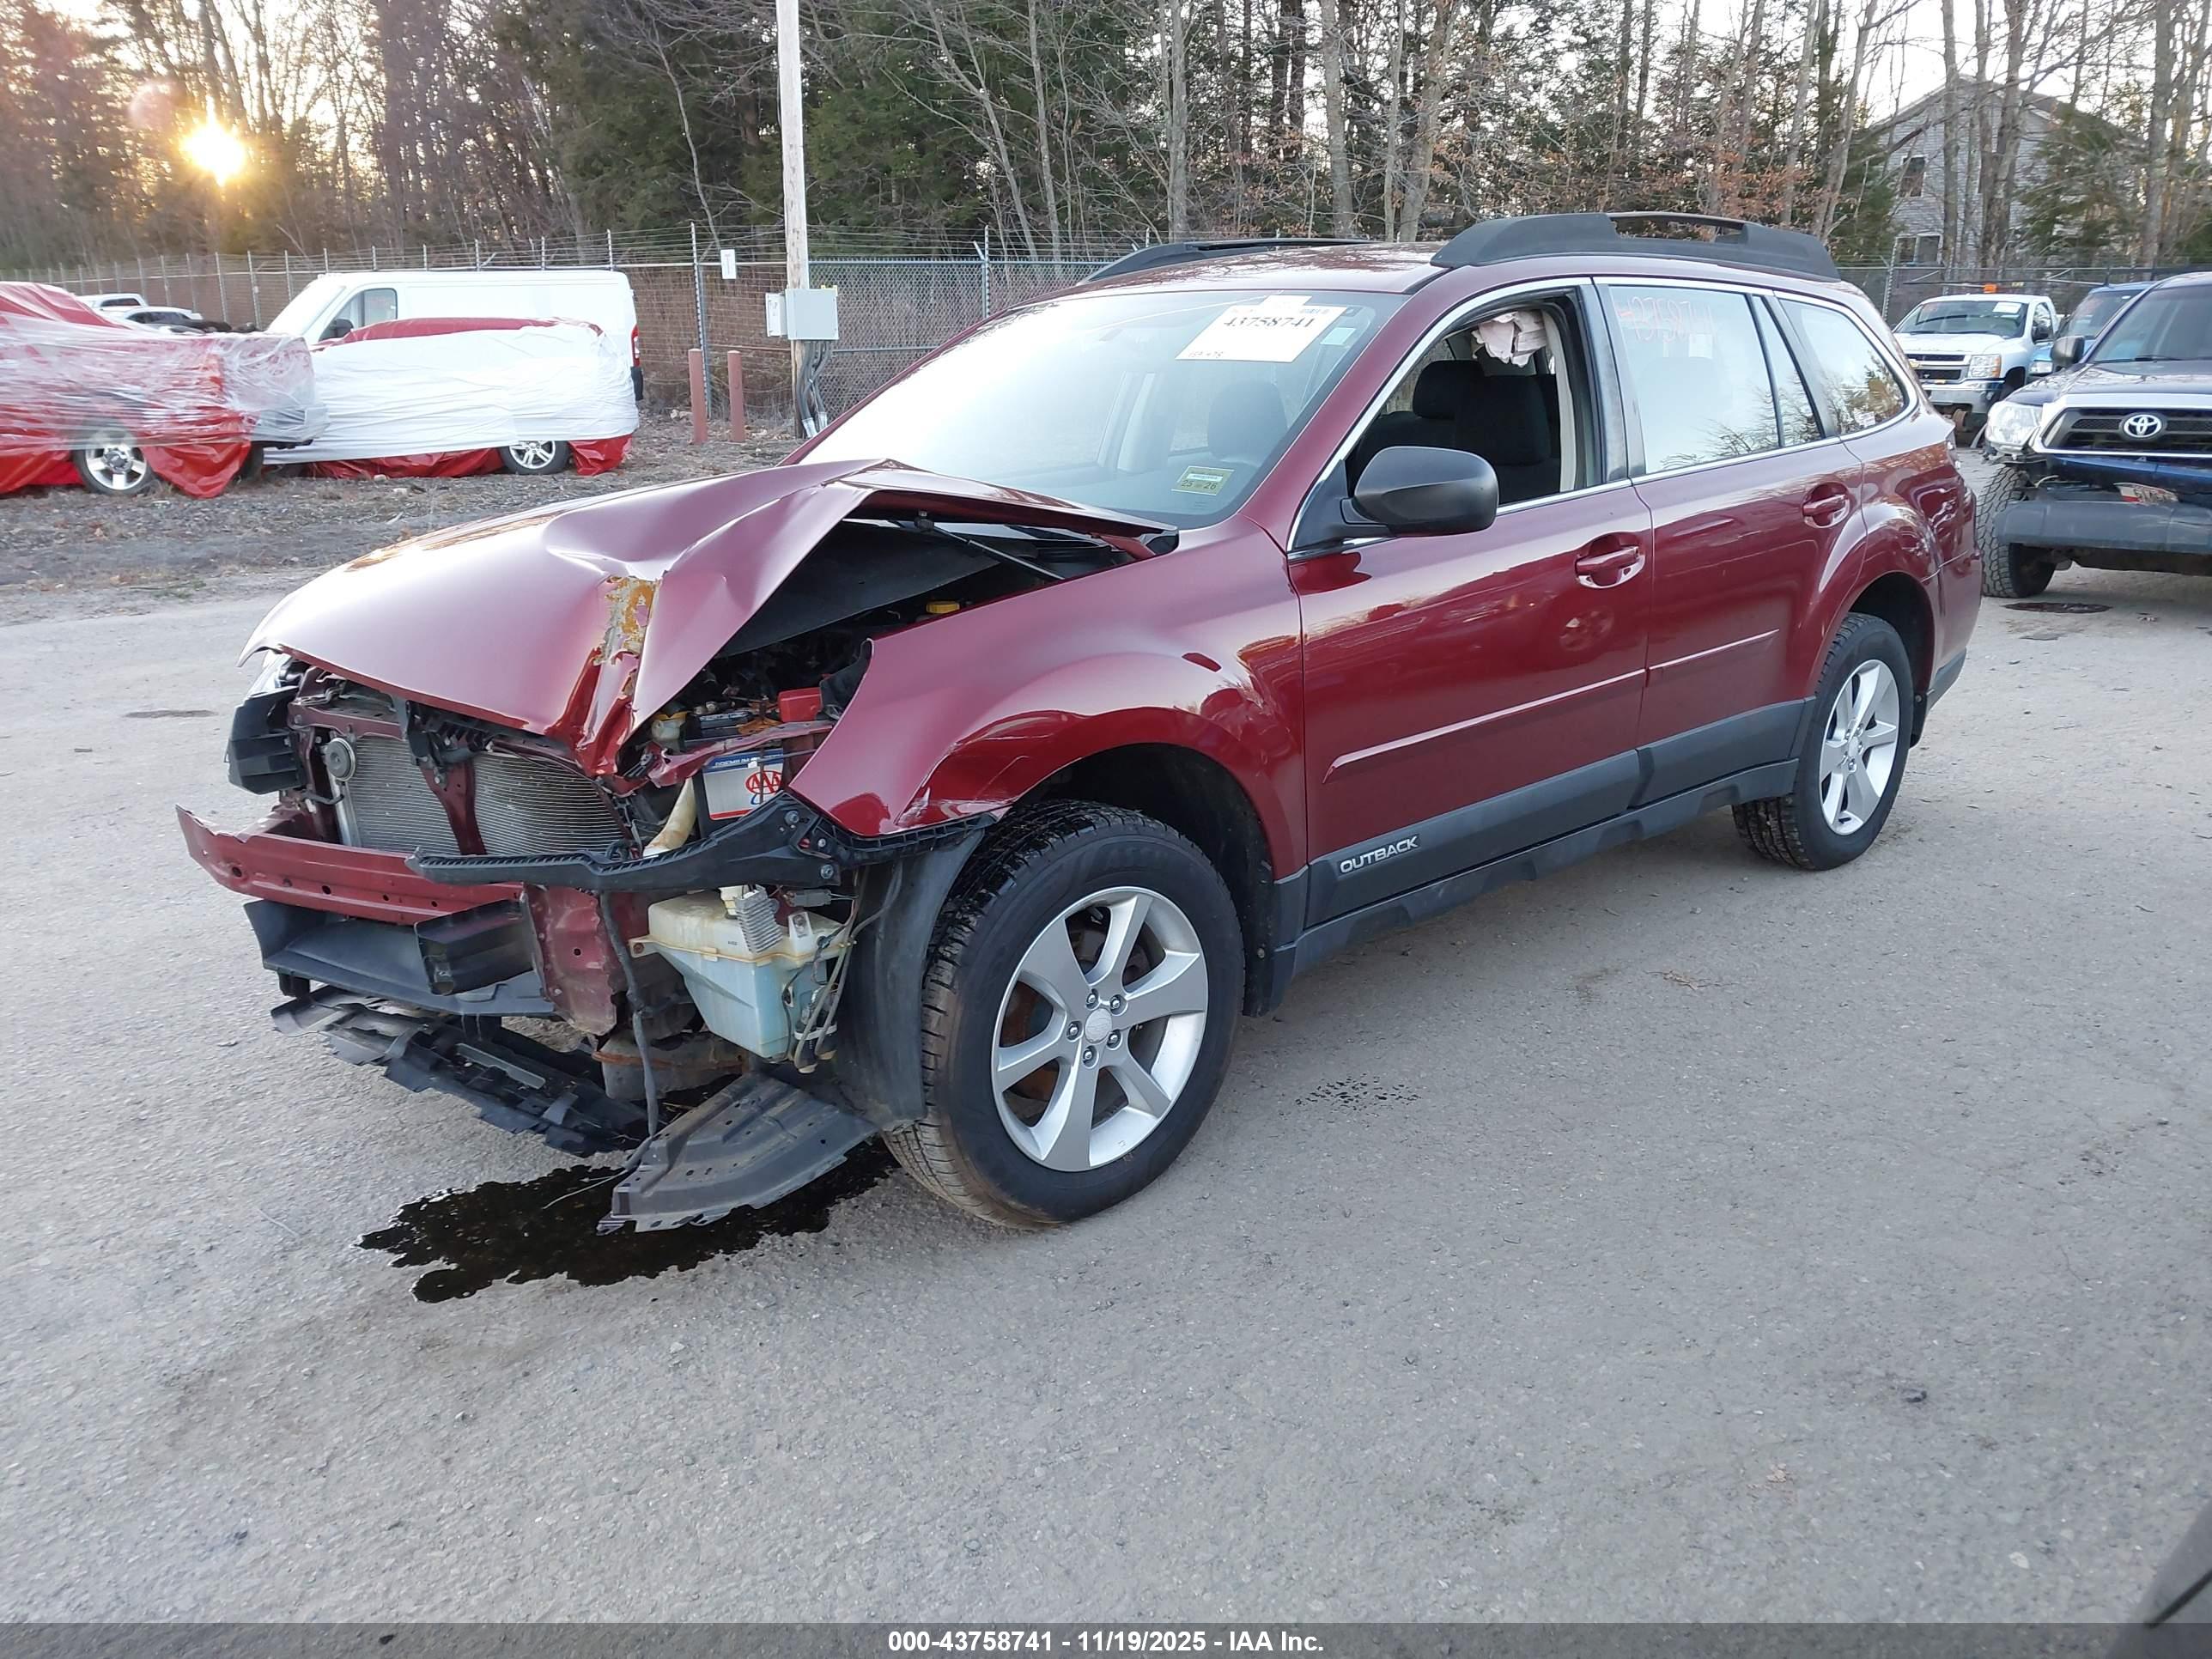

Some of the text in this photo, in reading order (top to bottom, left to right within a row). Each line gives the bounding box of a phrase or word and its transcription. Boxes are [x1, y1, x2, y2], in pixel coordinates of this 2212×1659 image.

[1224, 316, 1316, 329] 43758741
[1181, 479, 1218, 490] 25 26
[1340, 836, 1419, 874] OUTBACK
